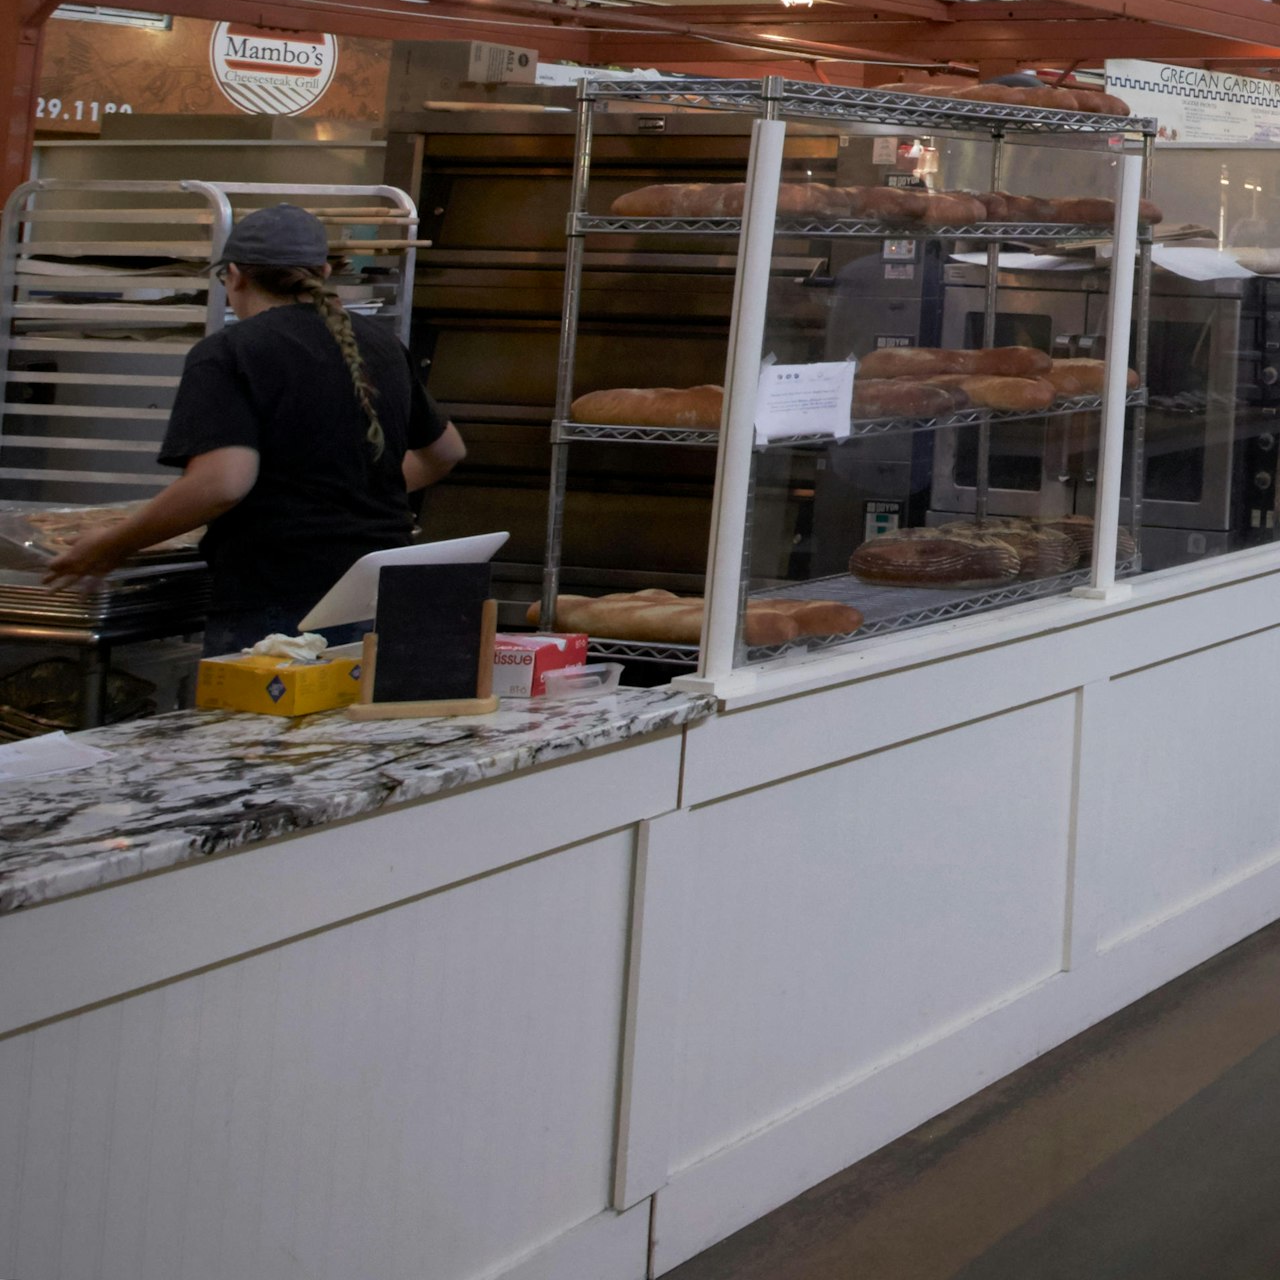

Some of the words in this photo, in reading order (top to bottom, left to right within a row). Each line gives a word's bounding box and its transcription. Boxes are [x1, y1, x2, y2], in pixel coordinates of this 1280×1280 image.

[224, 36, 324, 67] Mambo's
[224, 69, 292, 88] Cheesesteak
[294, 74, 321, 90] Grill
[1160, 66, 1220, 89] GRECIAN
[1222, 75, 1273, 97] GARDEN
[493, 651, 533, 665] tissue
